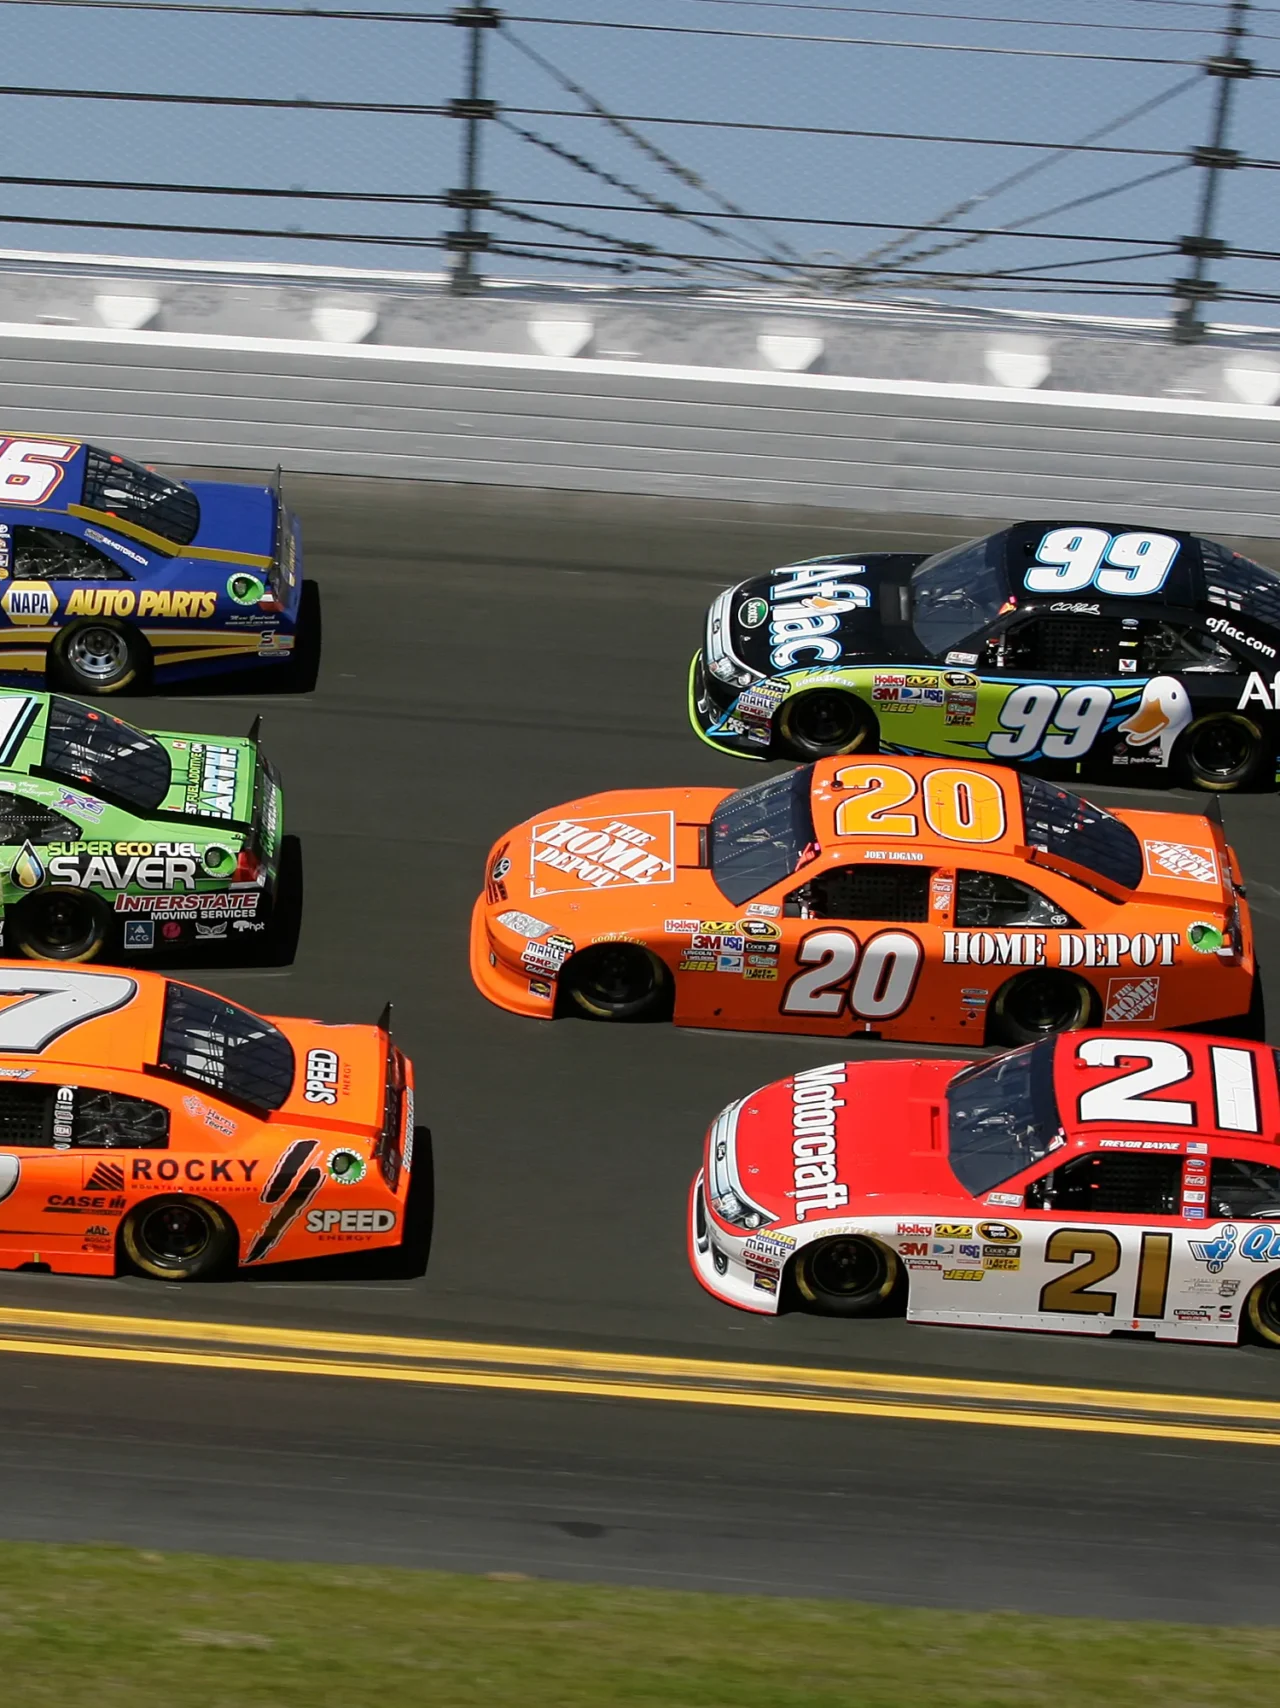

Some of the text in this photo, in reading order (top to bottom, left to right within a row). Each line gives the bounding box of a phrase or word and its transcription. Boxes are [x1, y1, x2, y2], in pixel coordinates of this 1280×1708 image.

[1023, 527, 1180, 596] 99
[11, 592, 49, 613] NAPA
[65, 590, 217, 618] AUTO PARTS
[747, 601, 761, 623] Scotts
[770, 564, 871, 669] Aflac
[1205, 617, 1276, 658] aflac.com
[874, 675, 904, 686] Holley
[740, 693, 774, 709] MAHLE
[751, 686, 783, 698] MOOG
[873, 688, 899, 700] 3M
[924, 690, 943, 702] USG
[881, 704, 916, 712] JEGS
[987, 684, 1113, 759] 99
[189, 752, 202, 784] ADDITIVE
[187, 783, 200, 802] FUEL
[834, 764, 1006, 843] 20
[600, 820, 656, 848] THE
[48, 842, 201, 857] SUPER ECO FUEL
[533, 820, 673, 884] HOME
[864, 850, 924, 861] JOEY LOGANO
[48, 857, 196, 889] SAVER
[534, 846, 620, 889] DEPOT
[114, 893, 260, 912] INTERSTATE
[151, 910, 256, 920] MOVING SERVICES
[249, 921, 265, 932] hpt
[666, 921, 699, 932] Holley
[528, 942, 564, 960] MAHLE
[693, 936, 721, 949] 3M
[723, 937, 742, 951] USG
[942, 931, 1180, 967] HOME DEPOT
[523, 954, 551, 966] COMP
[680, 961, 716, 971] JEGS
[779, 926, 925, 1020] 20
[305, 1048, 338, 1105] SPEED
[342, 1062, 352, 1095] ENERGY
[1076, 1037, 1262, 1135] 21
[205, 1116, 232, 1135] Teeter
[207, 1109, 235, 1129] Harris
[792, 1062, 850, 1217] Motorcraft
[1099, 1139, 1180, 1150] TREVOR BAYNE
[132, 1158, 260, 1182] ROCKY
[47, 1195, 105, 1209] CASE
[305, 1209, 396, 1233] SPEED
[897, 1223, 932, 1236] Holley
[759, 1229, 795, 1244] MOOG
[745, 1239, 786, 1257] MAHLE
[898, 1243, 928, 1256] 3M
[960, 1245, 980, 1258] USG
[984, 1247, 1007, 1255] Coors
[743, 1250, 773, 1265] COMP
[944, 1269, 985, 1280] JEGS
[1038, 1227, 1173, 1319] 21
